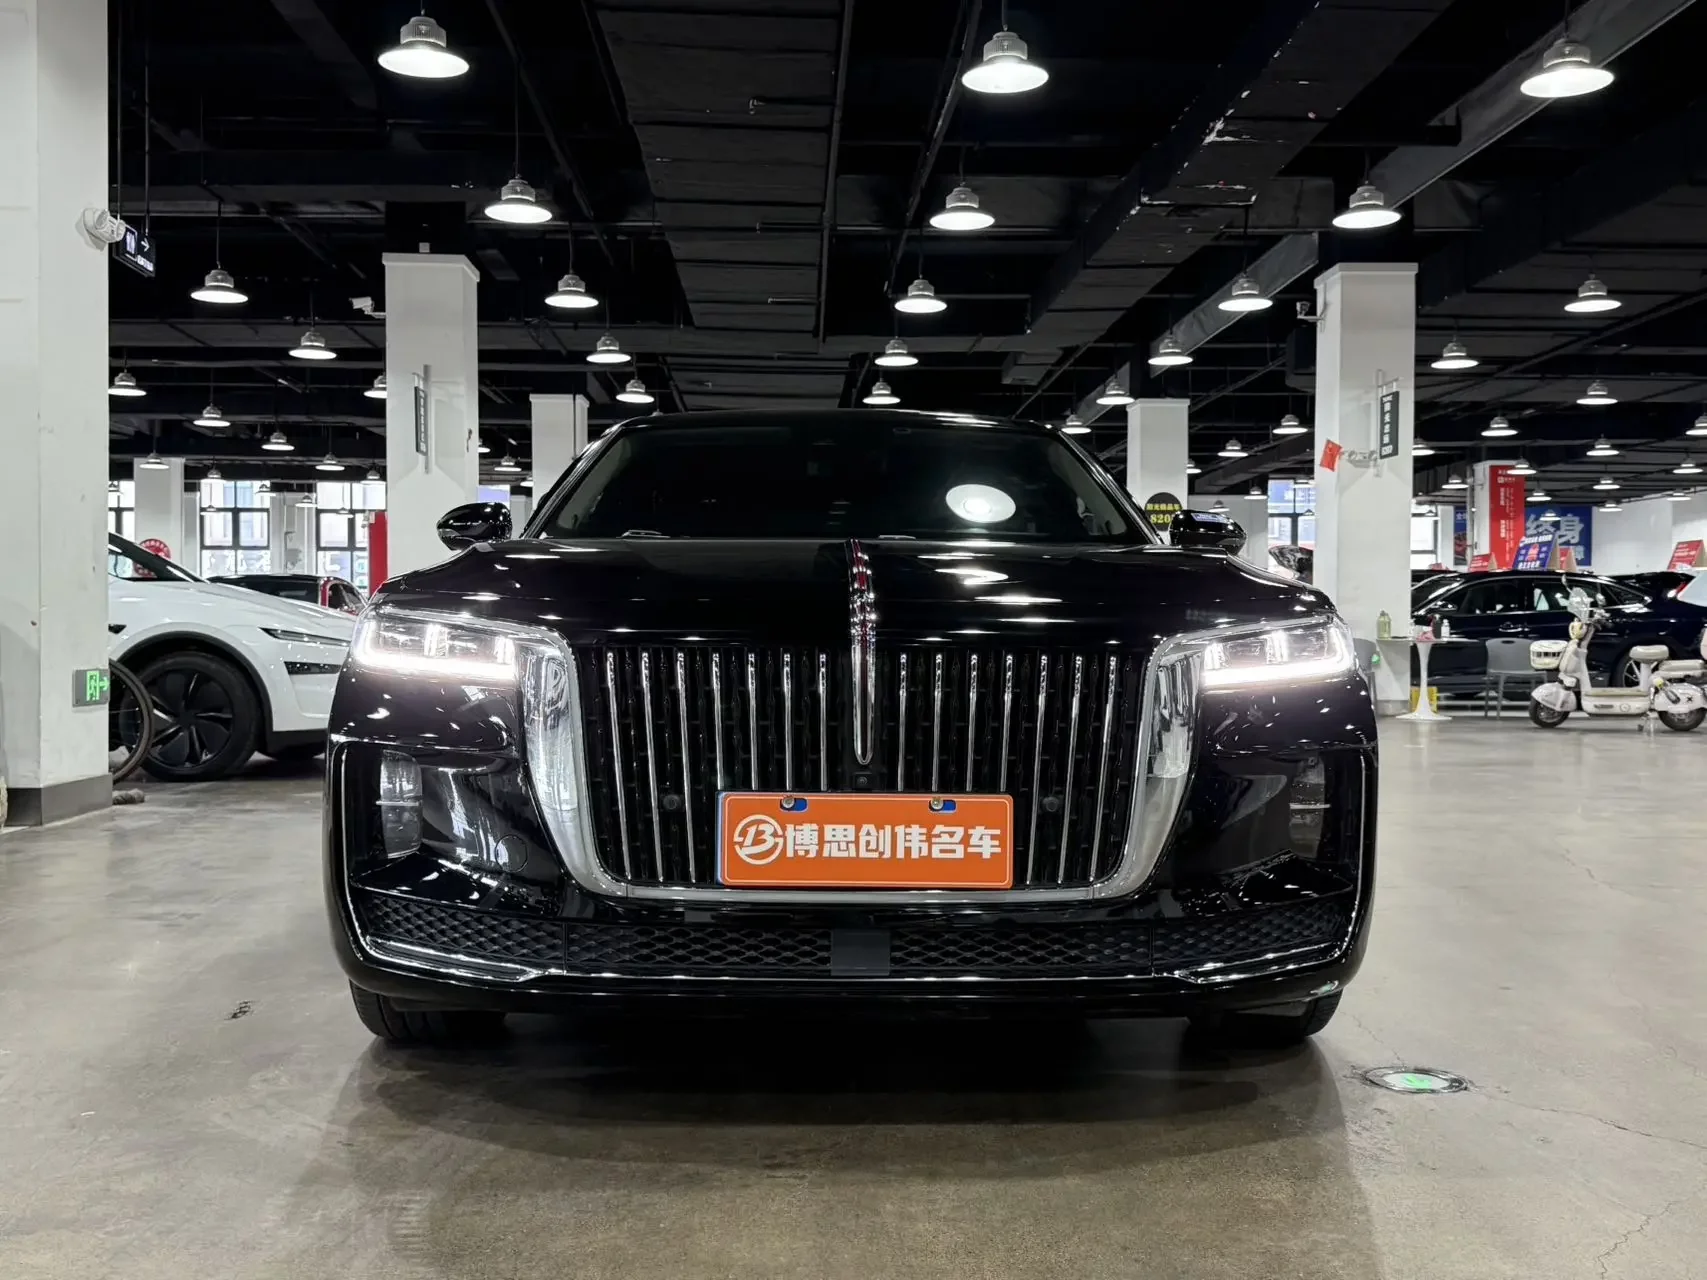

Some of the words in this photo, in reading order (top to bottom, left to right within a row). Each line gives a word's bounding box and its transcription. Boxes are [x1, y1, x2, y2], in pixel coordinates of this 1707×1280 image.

[785, 823, 1001, 859] 博思创伟名车
